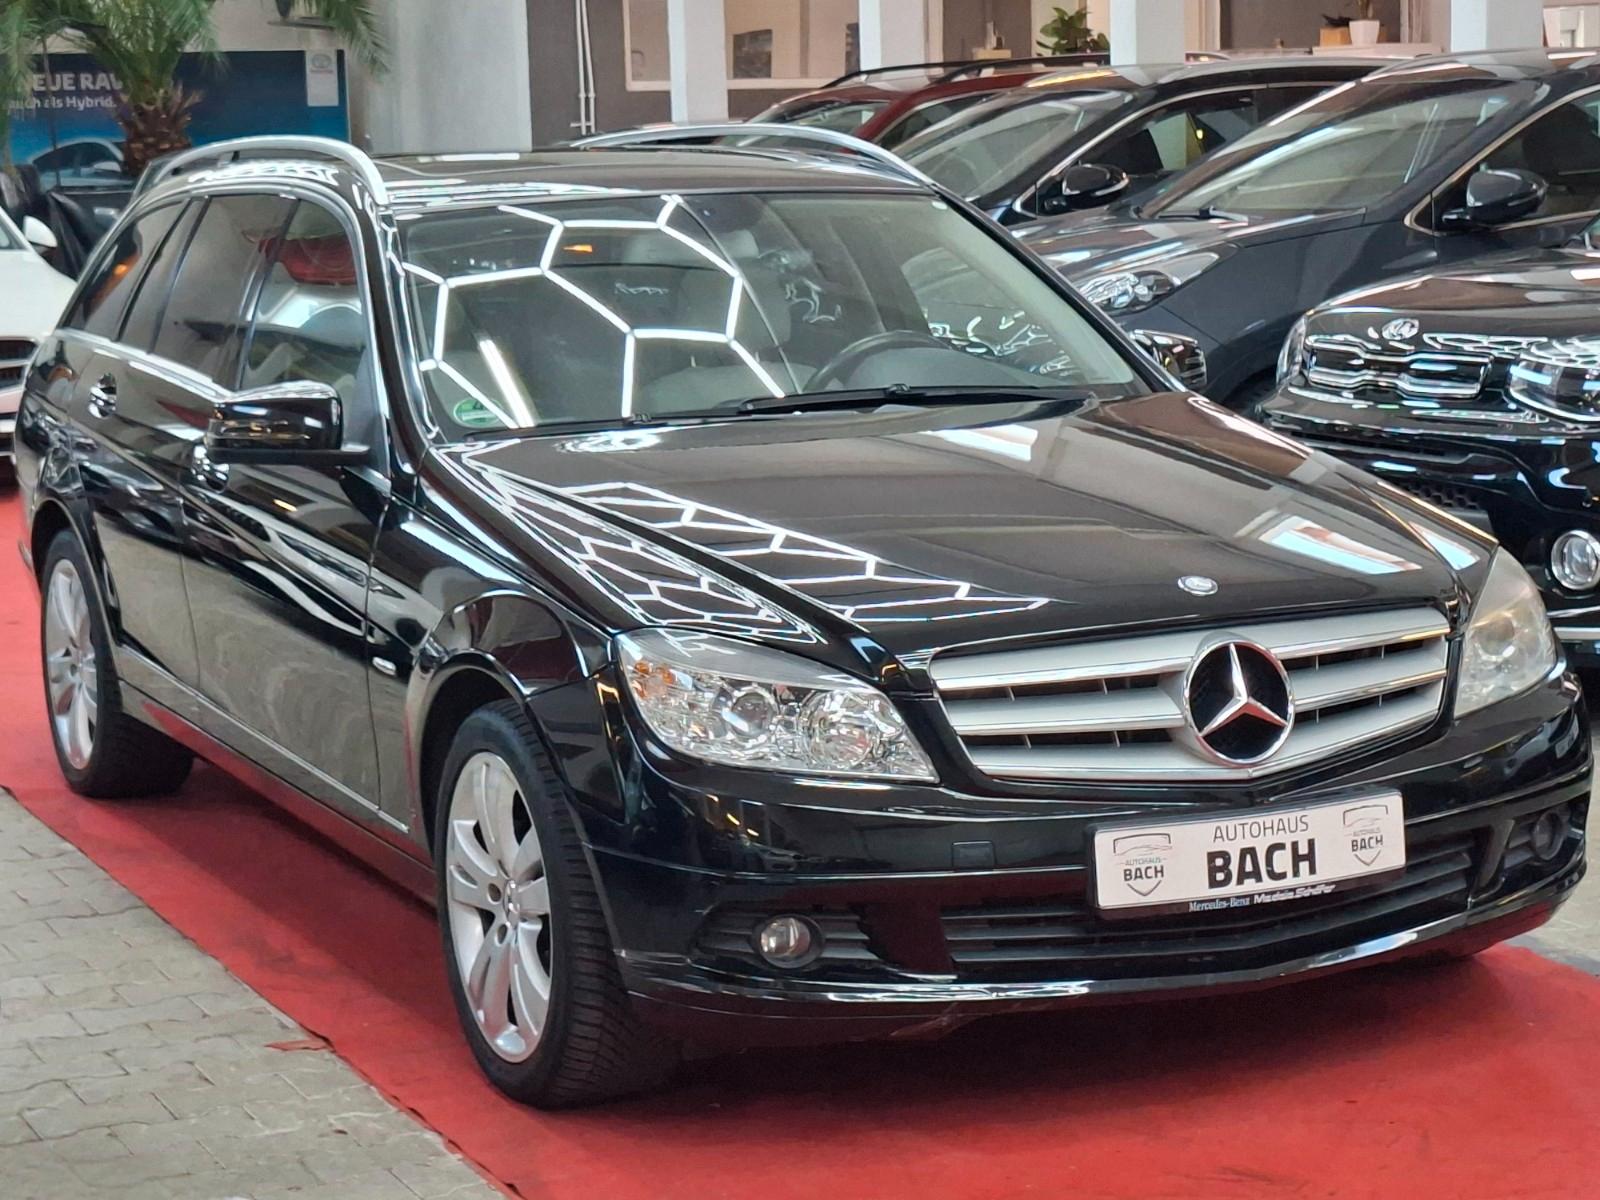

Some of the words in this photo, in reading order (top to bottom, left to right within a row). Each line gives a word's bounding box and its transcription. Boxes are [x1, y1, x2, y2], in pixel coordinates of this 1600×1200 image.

[1213, 814, 1309, 843] AUTOHAUS
[1351, 834, 1384, 853] BACH
[1207, 838, 1317, 889] BACH
[1123, 865, 1164, 882] BACH
[1188, 896, 1250, 913] Mercedes-Benz
